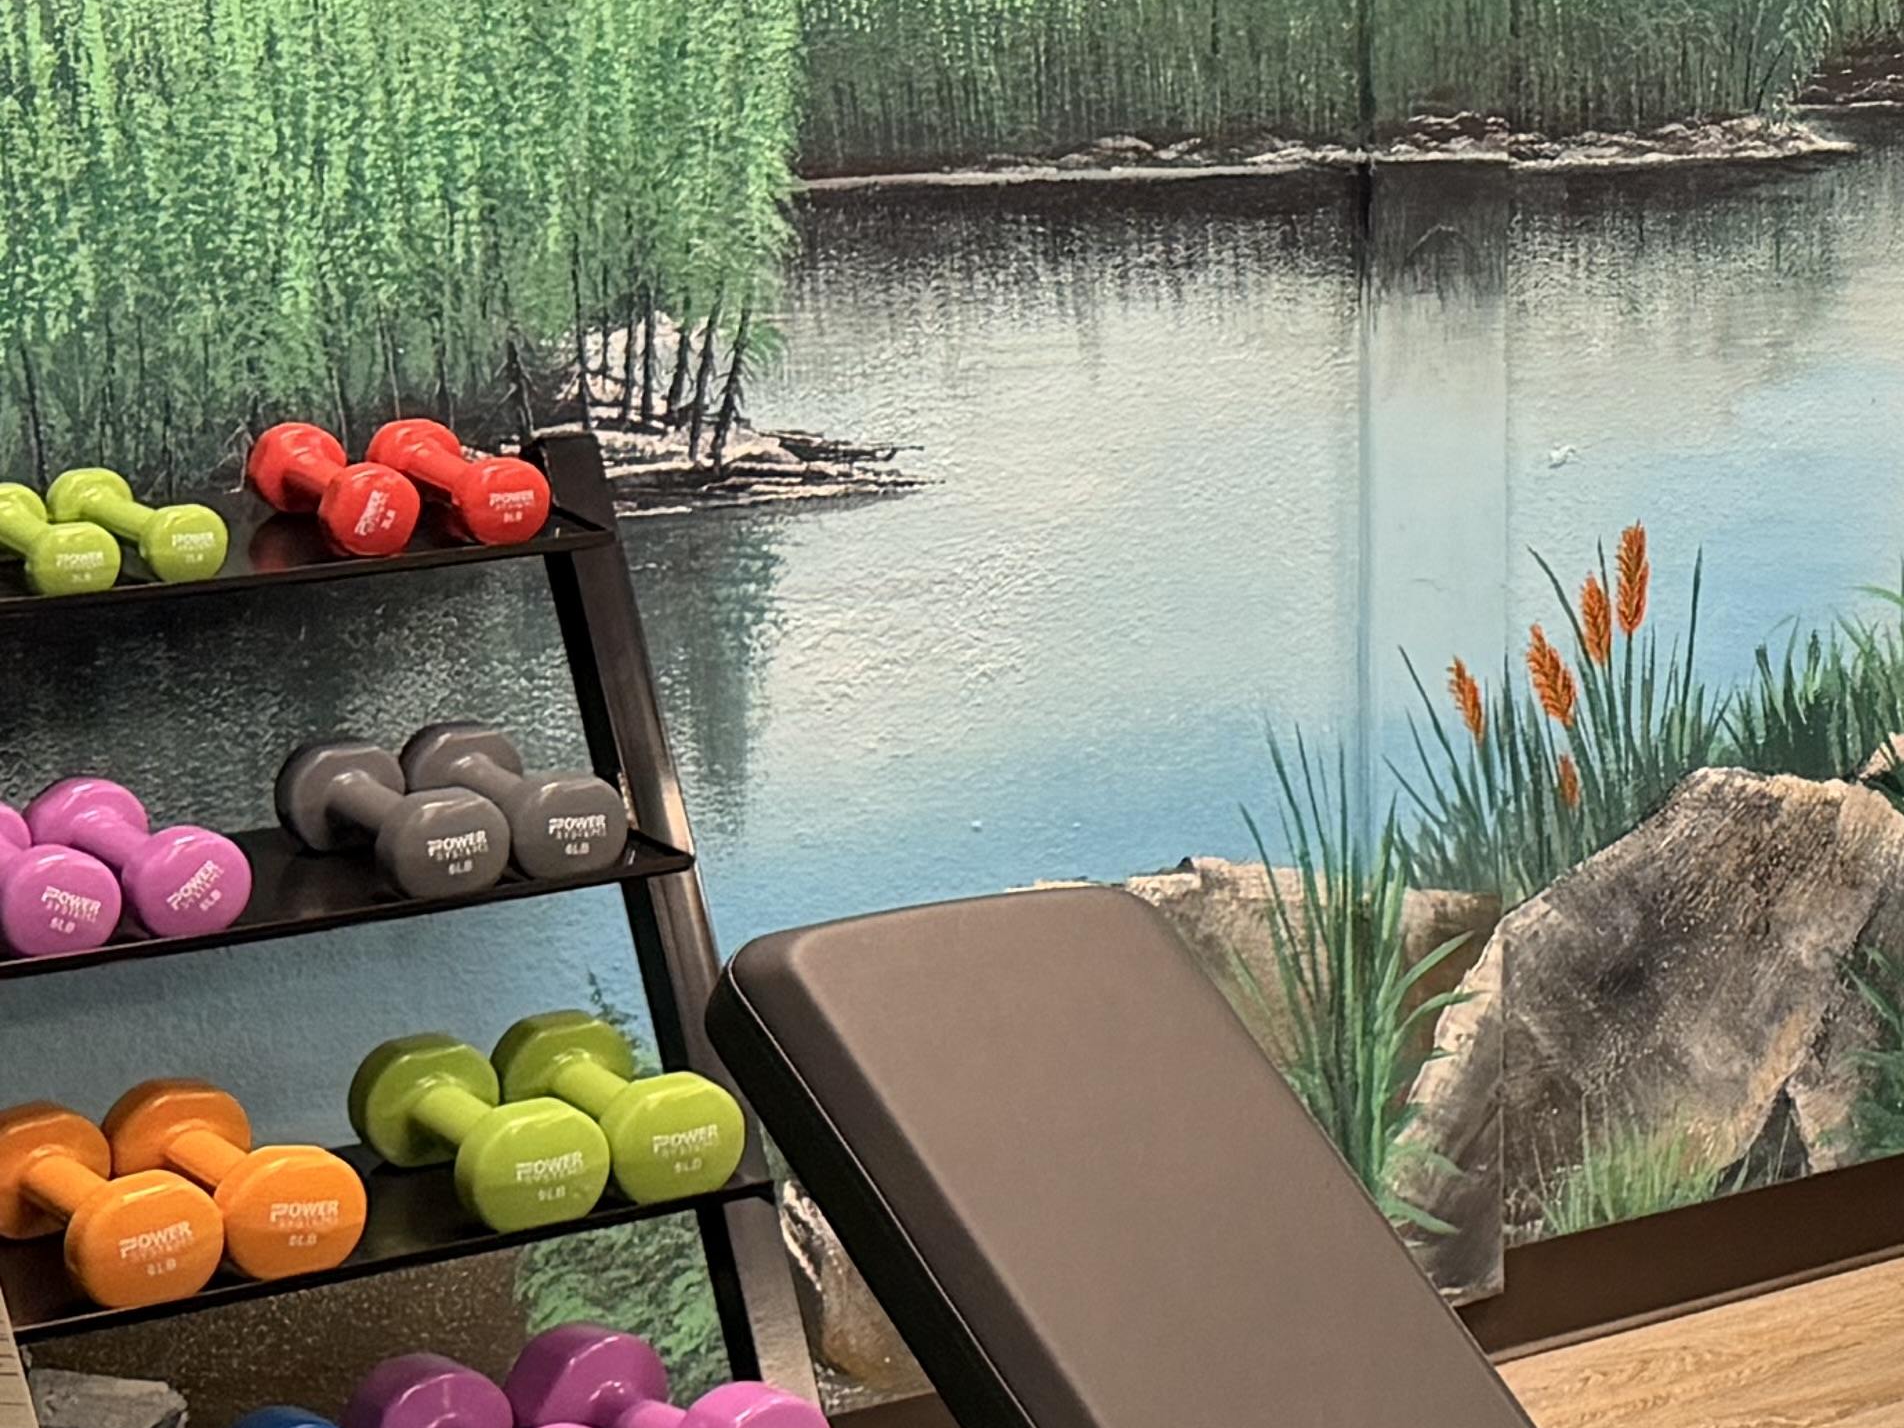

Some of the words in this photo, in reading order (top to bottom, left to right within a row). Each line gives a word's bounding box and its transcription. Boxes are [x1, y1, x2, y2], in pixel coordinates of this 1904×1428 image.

[548, 814, 607, 835] POWER
[427, 830, 488, 858] POWER
[41, 884, 102, 915] POWER
[166, 859, 221, 912] POWER
[652, 1123, 719, 1154] POWER
[515, 1149, 584, 1182] POWER
[270, 1199, 340, 1223] POWER
[118, 1220, 193, 1260] POWER
